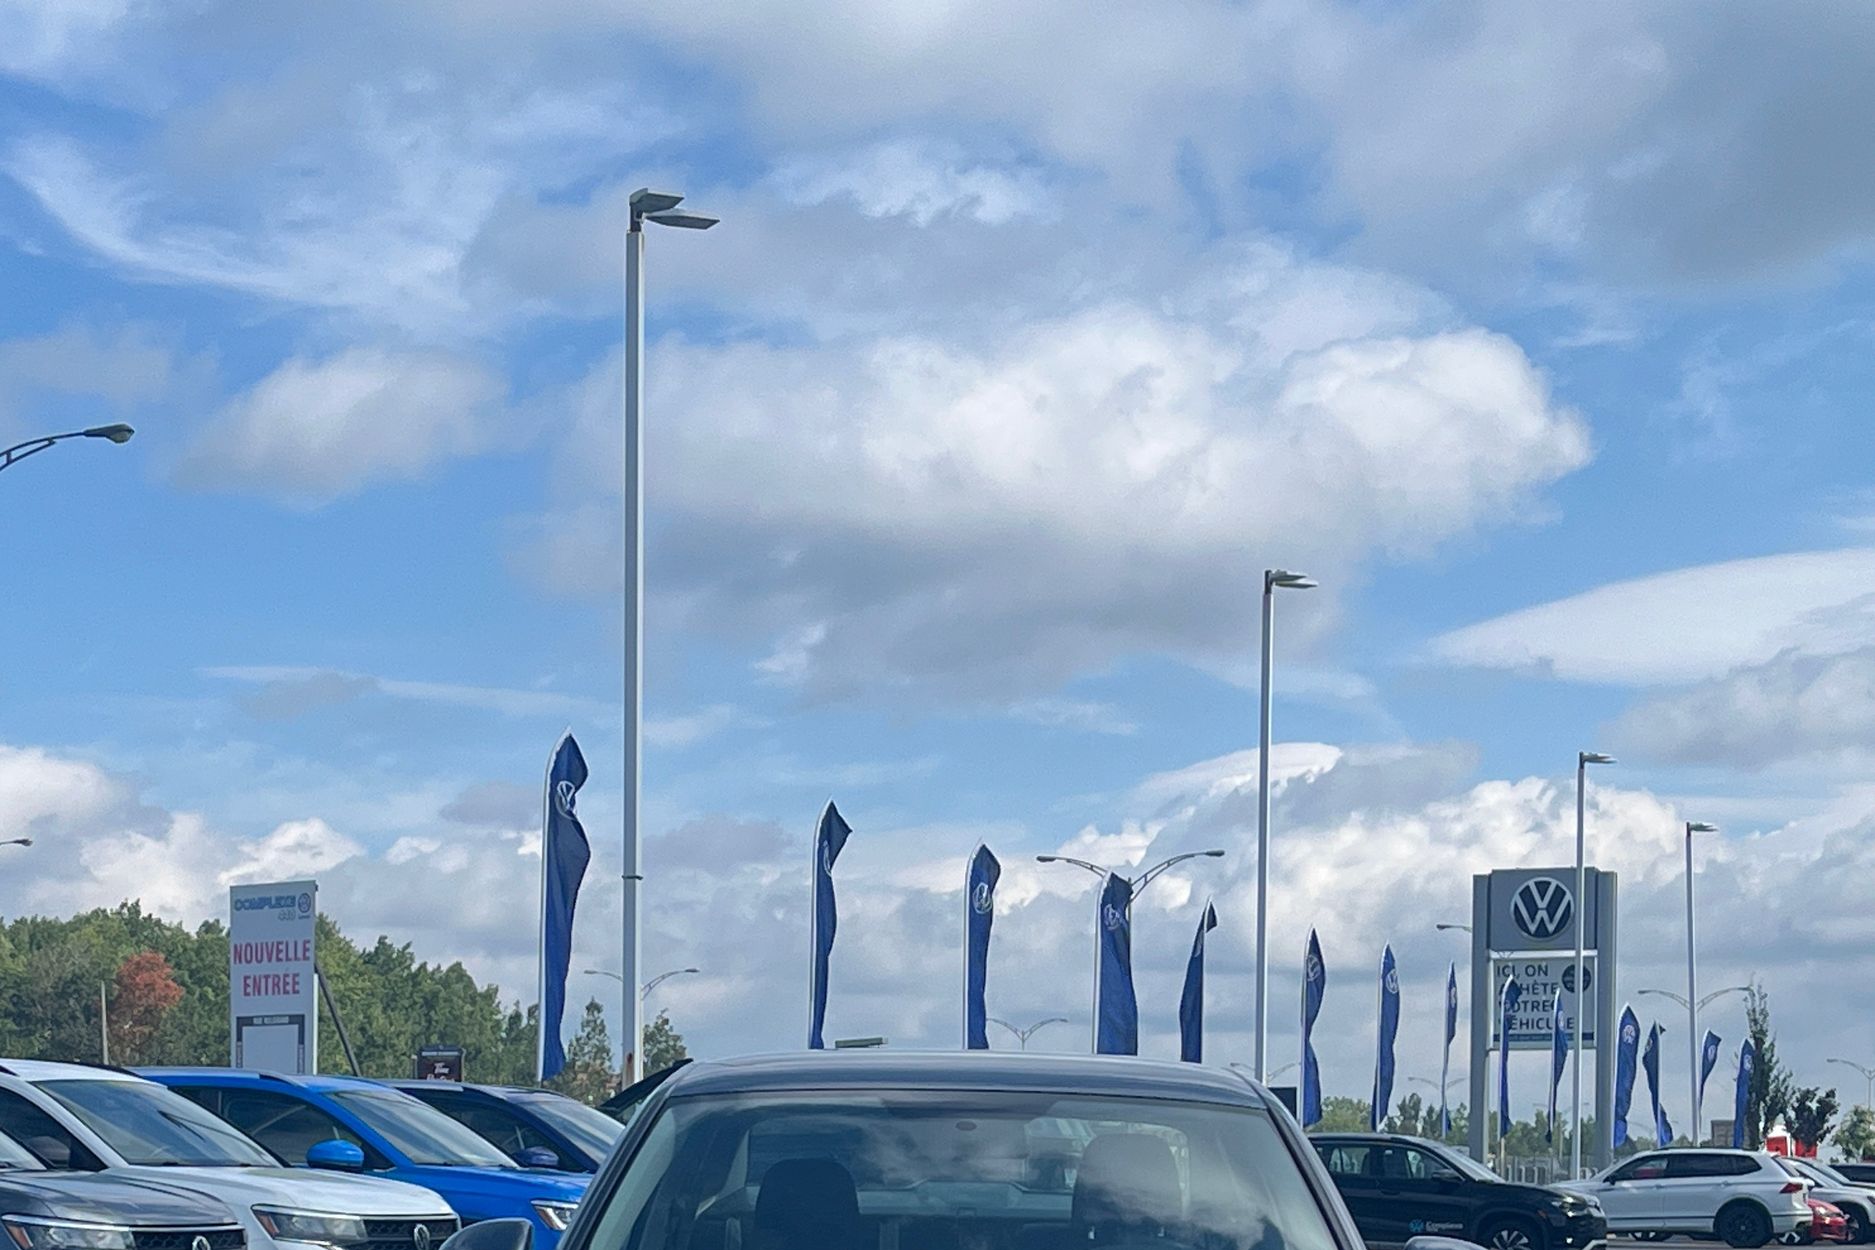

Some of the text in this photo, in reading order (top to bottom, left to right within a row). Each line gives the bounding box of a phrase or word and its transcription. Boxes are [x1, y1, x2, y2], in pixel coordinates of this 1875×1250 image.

[233, 940, 311, 965] NOUVELLE
[243, 967, 300, 997] ENTRÉE
[1525, 964, 1548, 977] ON
